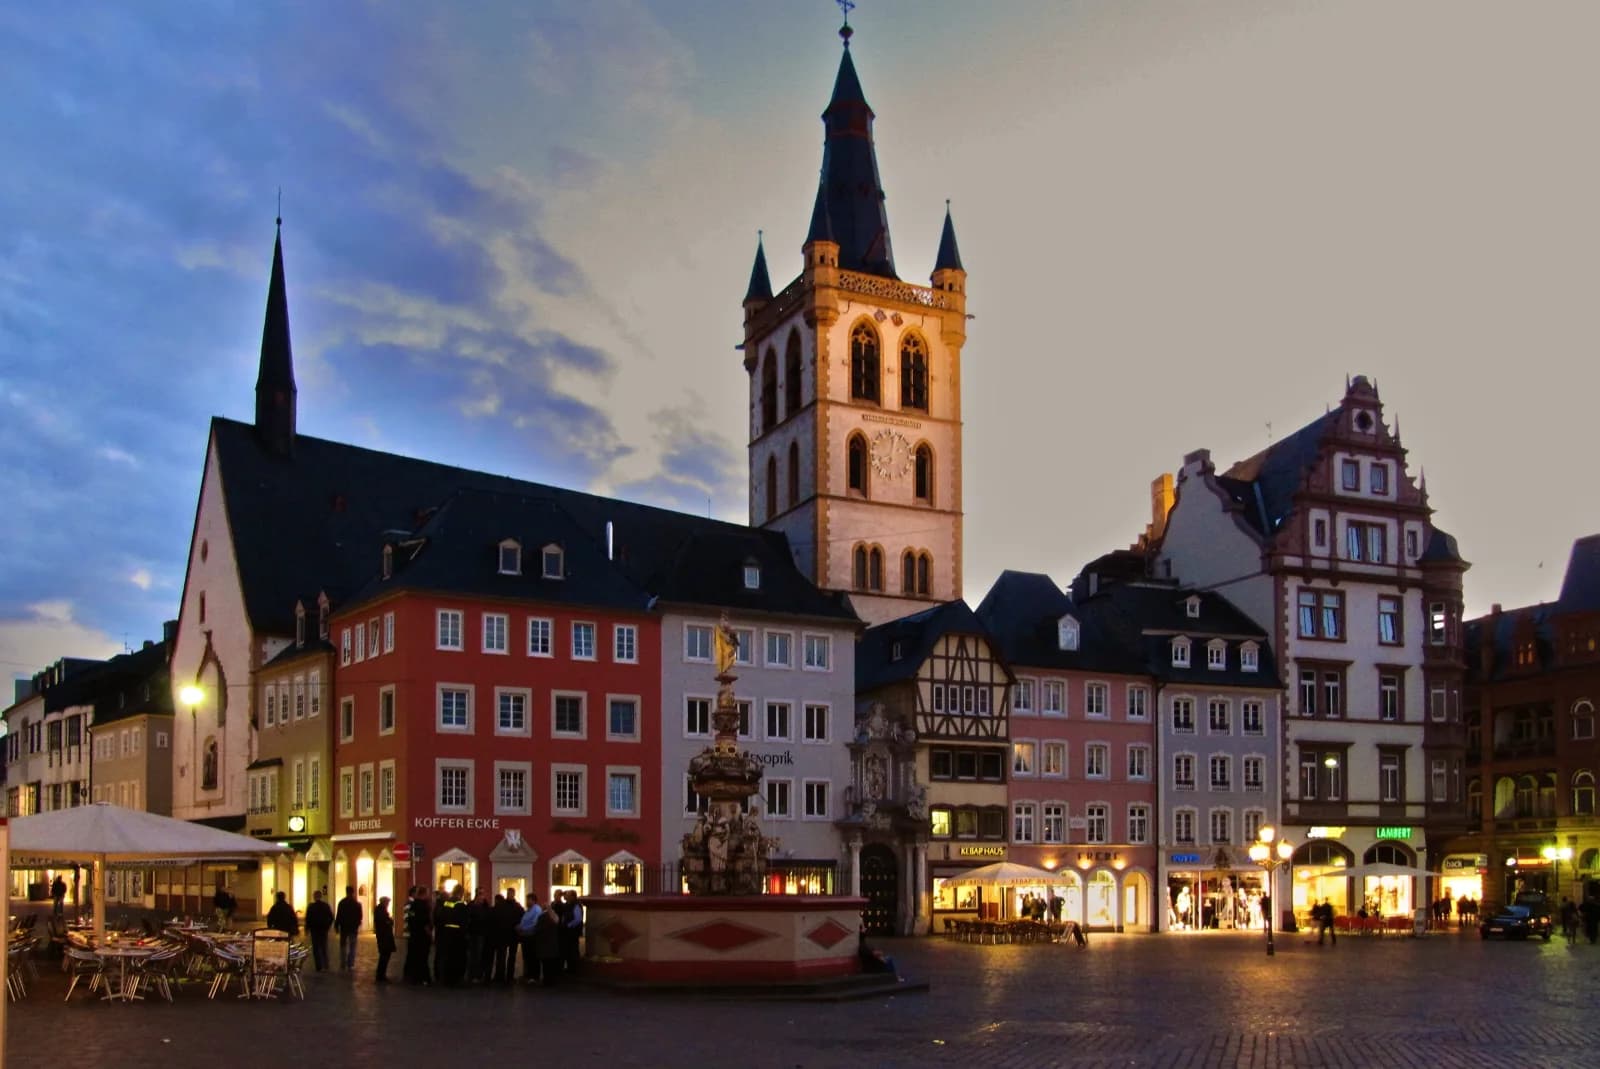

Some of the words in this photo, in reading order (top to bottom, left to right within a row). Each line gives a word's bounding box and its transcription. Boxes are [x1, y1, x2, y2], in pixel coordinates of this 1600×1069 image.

[415, 817, 464, 829] KOFFER
[466, 818, 500, 829] ECKE
[1376, 827, 1411, 839] LAMBERT
[983, 847, 1003, 856] HAUS
